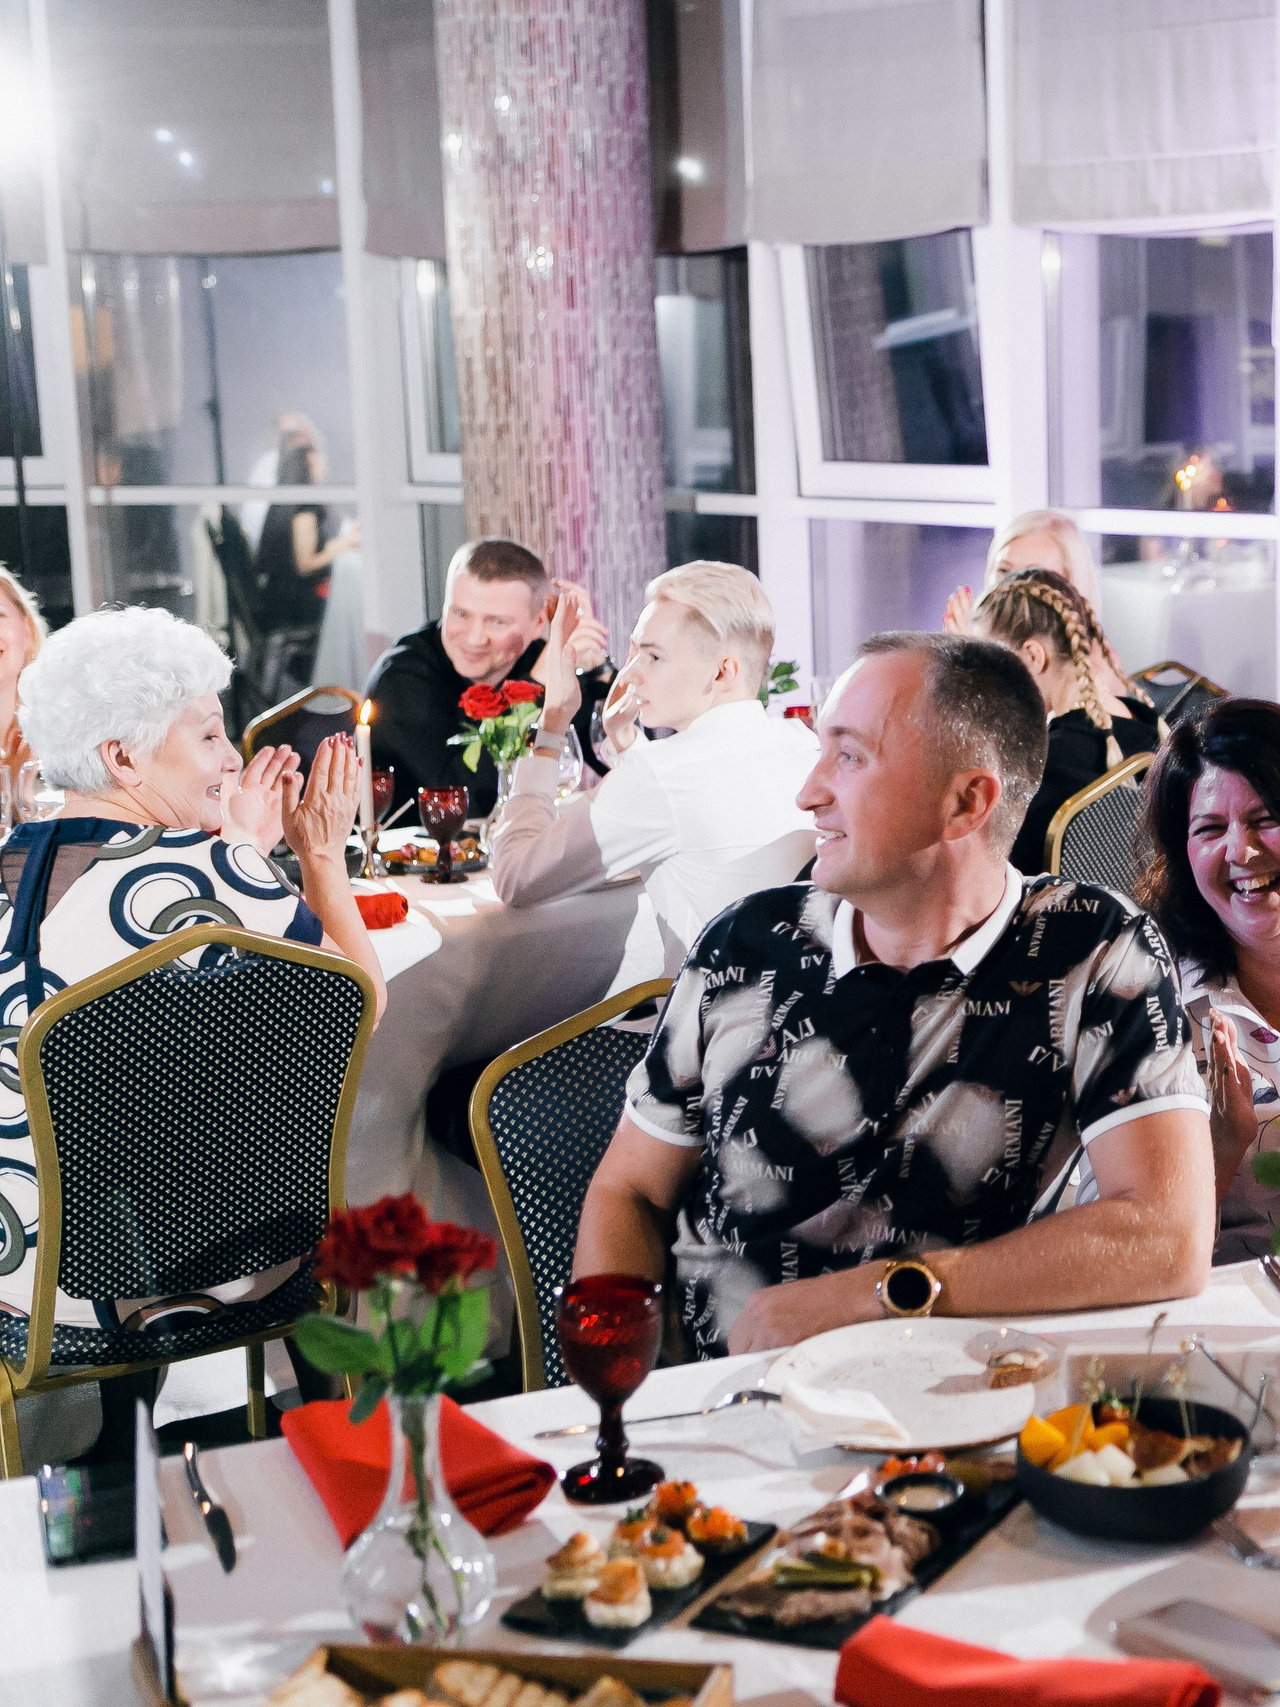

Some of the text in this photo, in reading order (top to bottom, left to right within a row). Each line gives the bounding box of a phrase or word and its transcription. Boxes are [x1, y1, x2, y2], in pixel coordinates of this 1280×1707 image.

[1027, 915, 1046, 957] ARMANI
[771, 990, 804, 1031] ARMANI
[1048, 979, 1067, 1051] ARMANI
[782, 1017, 815, 1048] A/J
[722, 1096, 749, 1141] ARMANI
[1005, 1099, 1023, 1169] ARMANI
[781, 1241, 799, 1283] MANI
